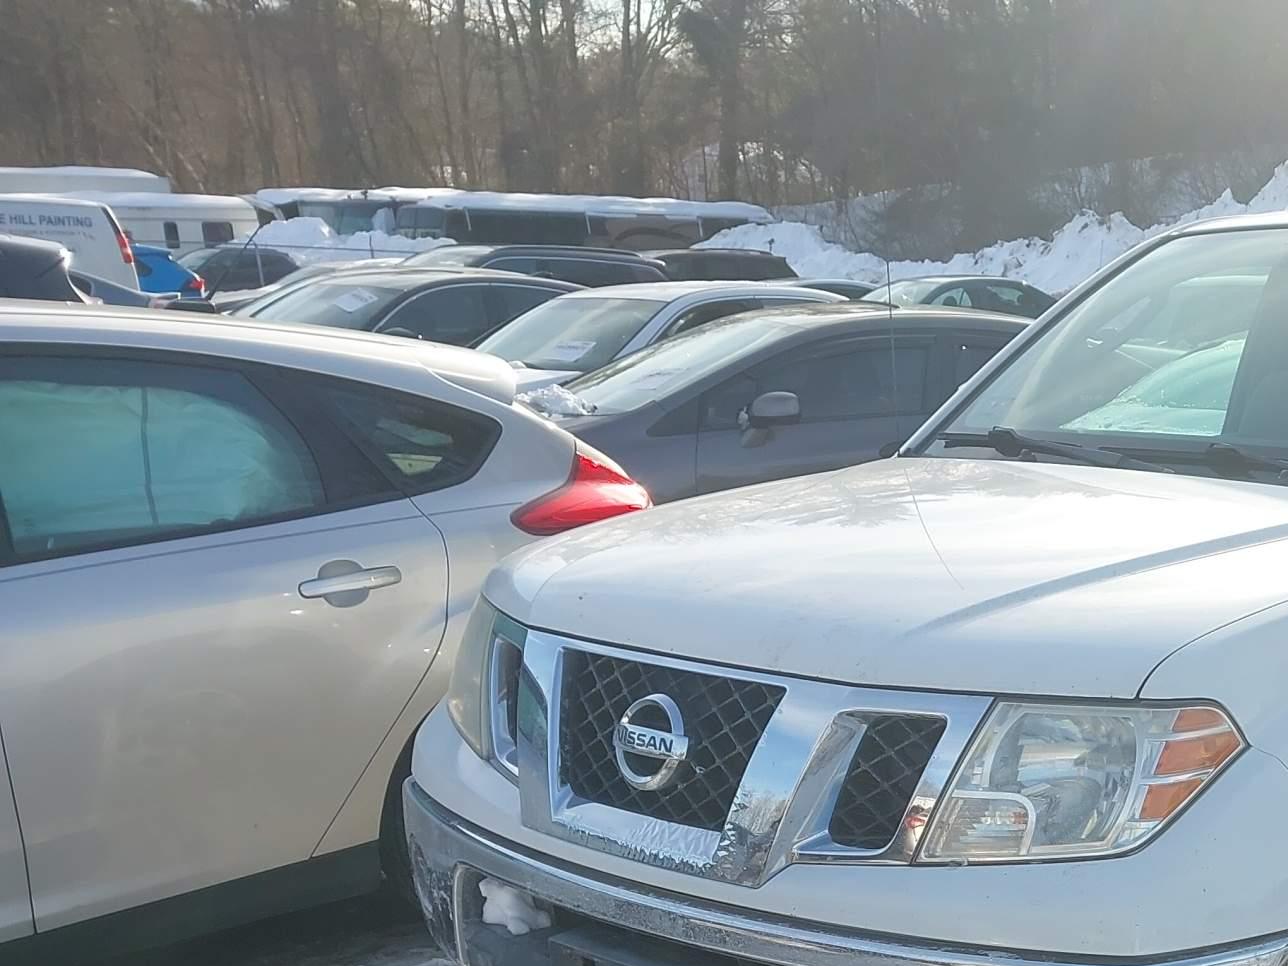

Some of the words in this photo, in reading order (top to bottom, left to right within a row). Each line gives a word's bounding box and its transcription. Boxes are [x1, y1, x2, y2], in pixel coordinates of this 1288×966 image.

[9, 215, 36, 226] HILL
[39, 214, 93, 228] PAINTING
[617, 724, 674, 753] NISSAN
